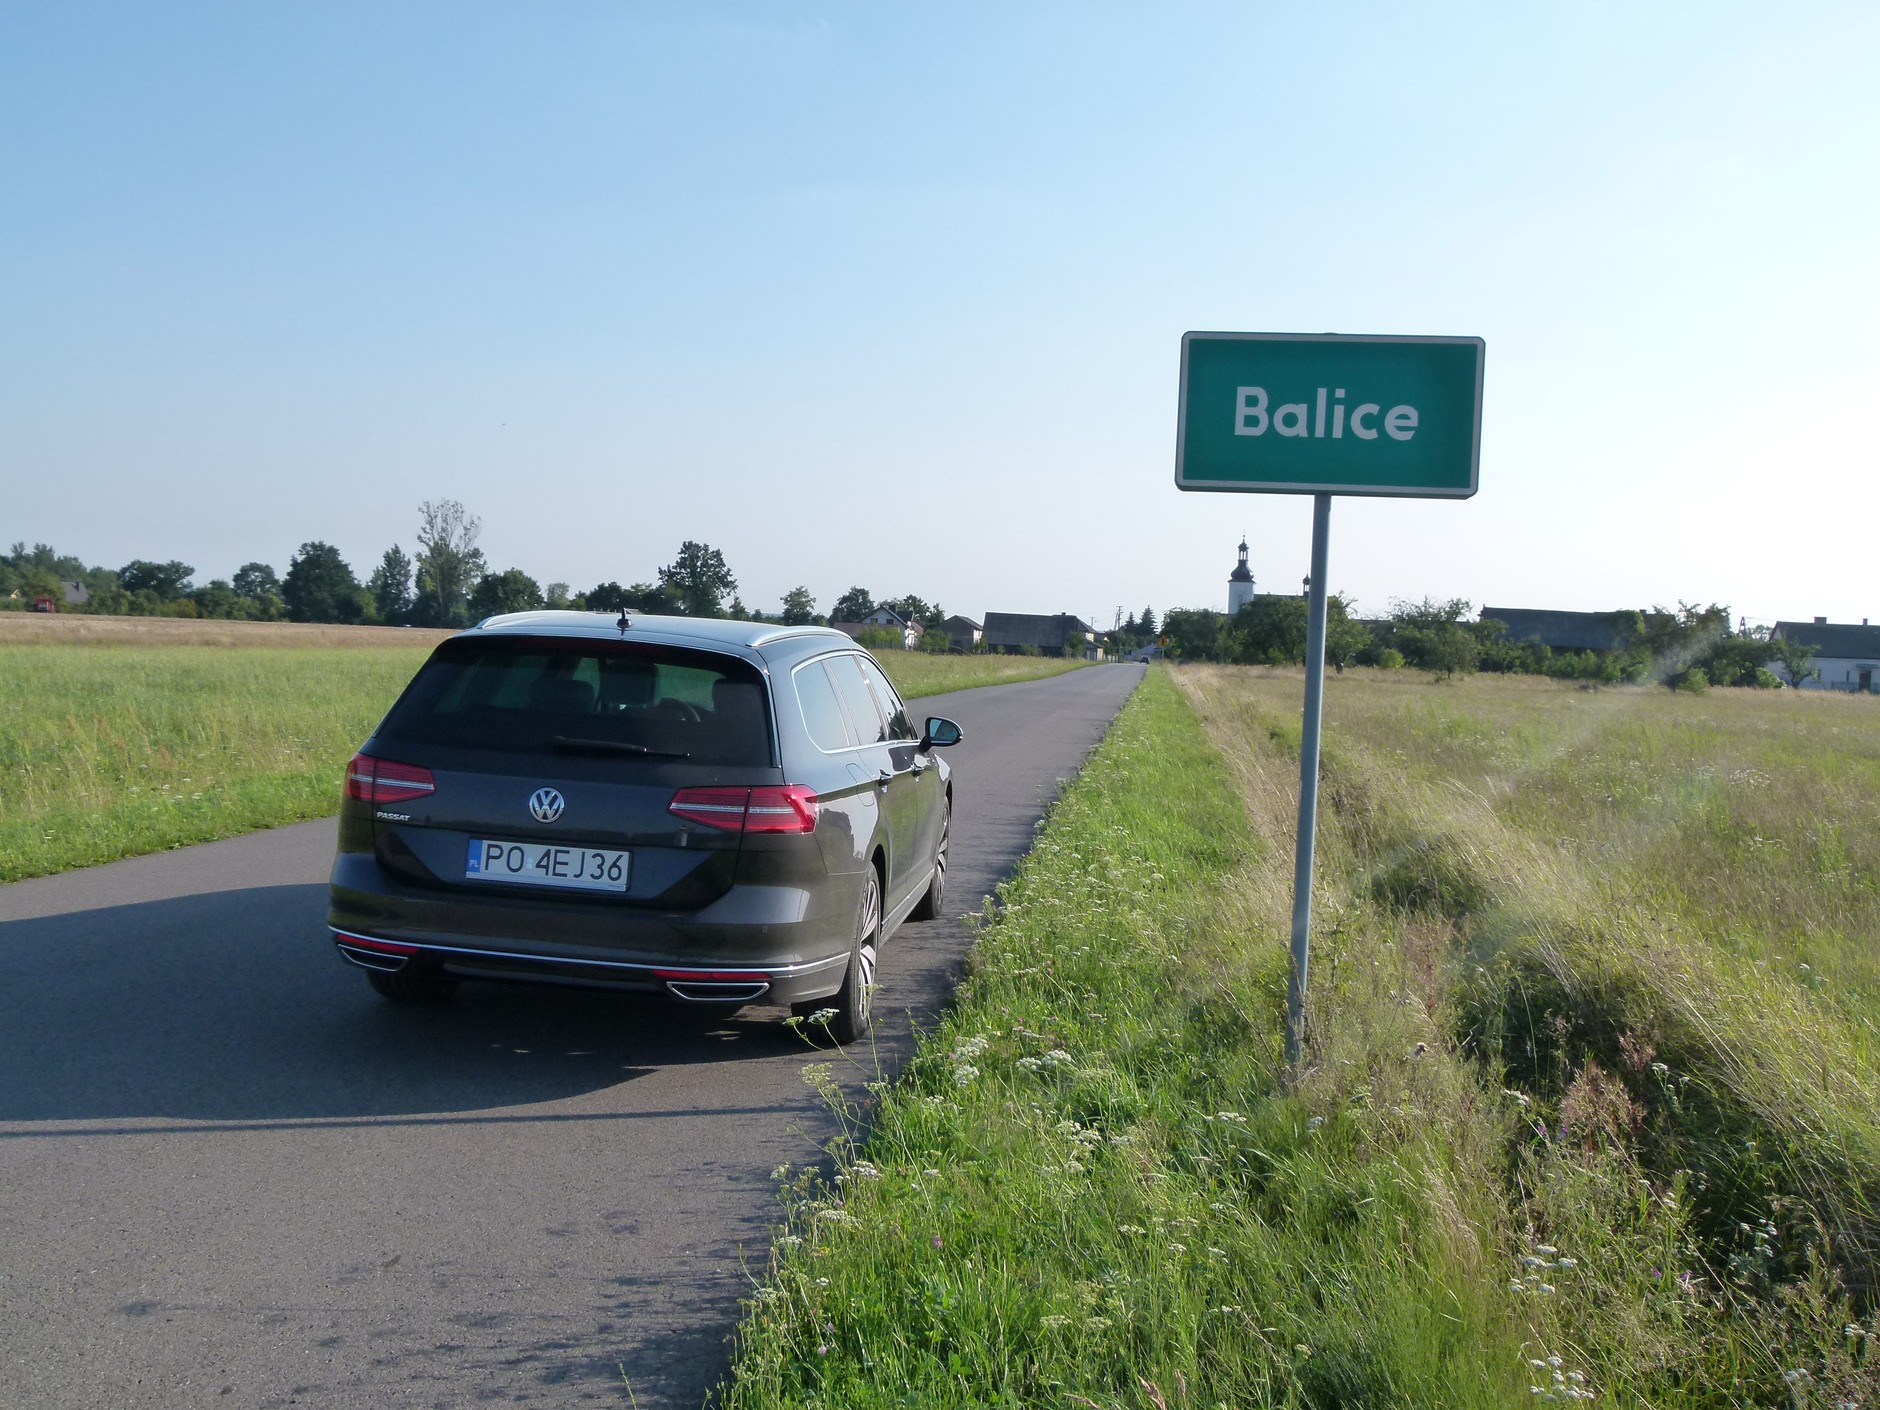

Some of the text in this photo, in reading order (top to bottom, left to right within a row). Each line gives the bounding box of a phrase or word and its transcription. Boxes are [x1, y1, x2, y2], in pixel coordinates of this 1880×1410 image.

[1234, 386, 1419, 441] Balice
[376, 811, 411, 822] PASSAT
[530, 787, 565, 823] VW
[469, 859, 480, 868] PL
[484, 843, 624, 882] PO 4EJ36
